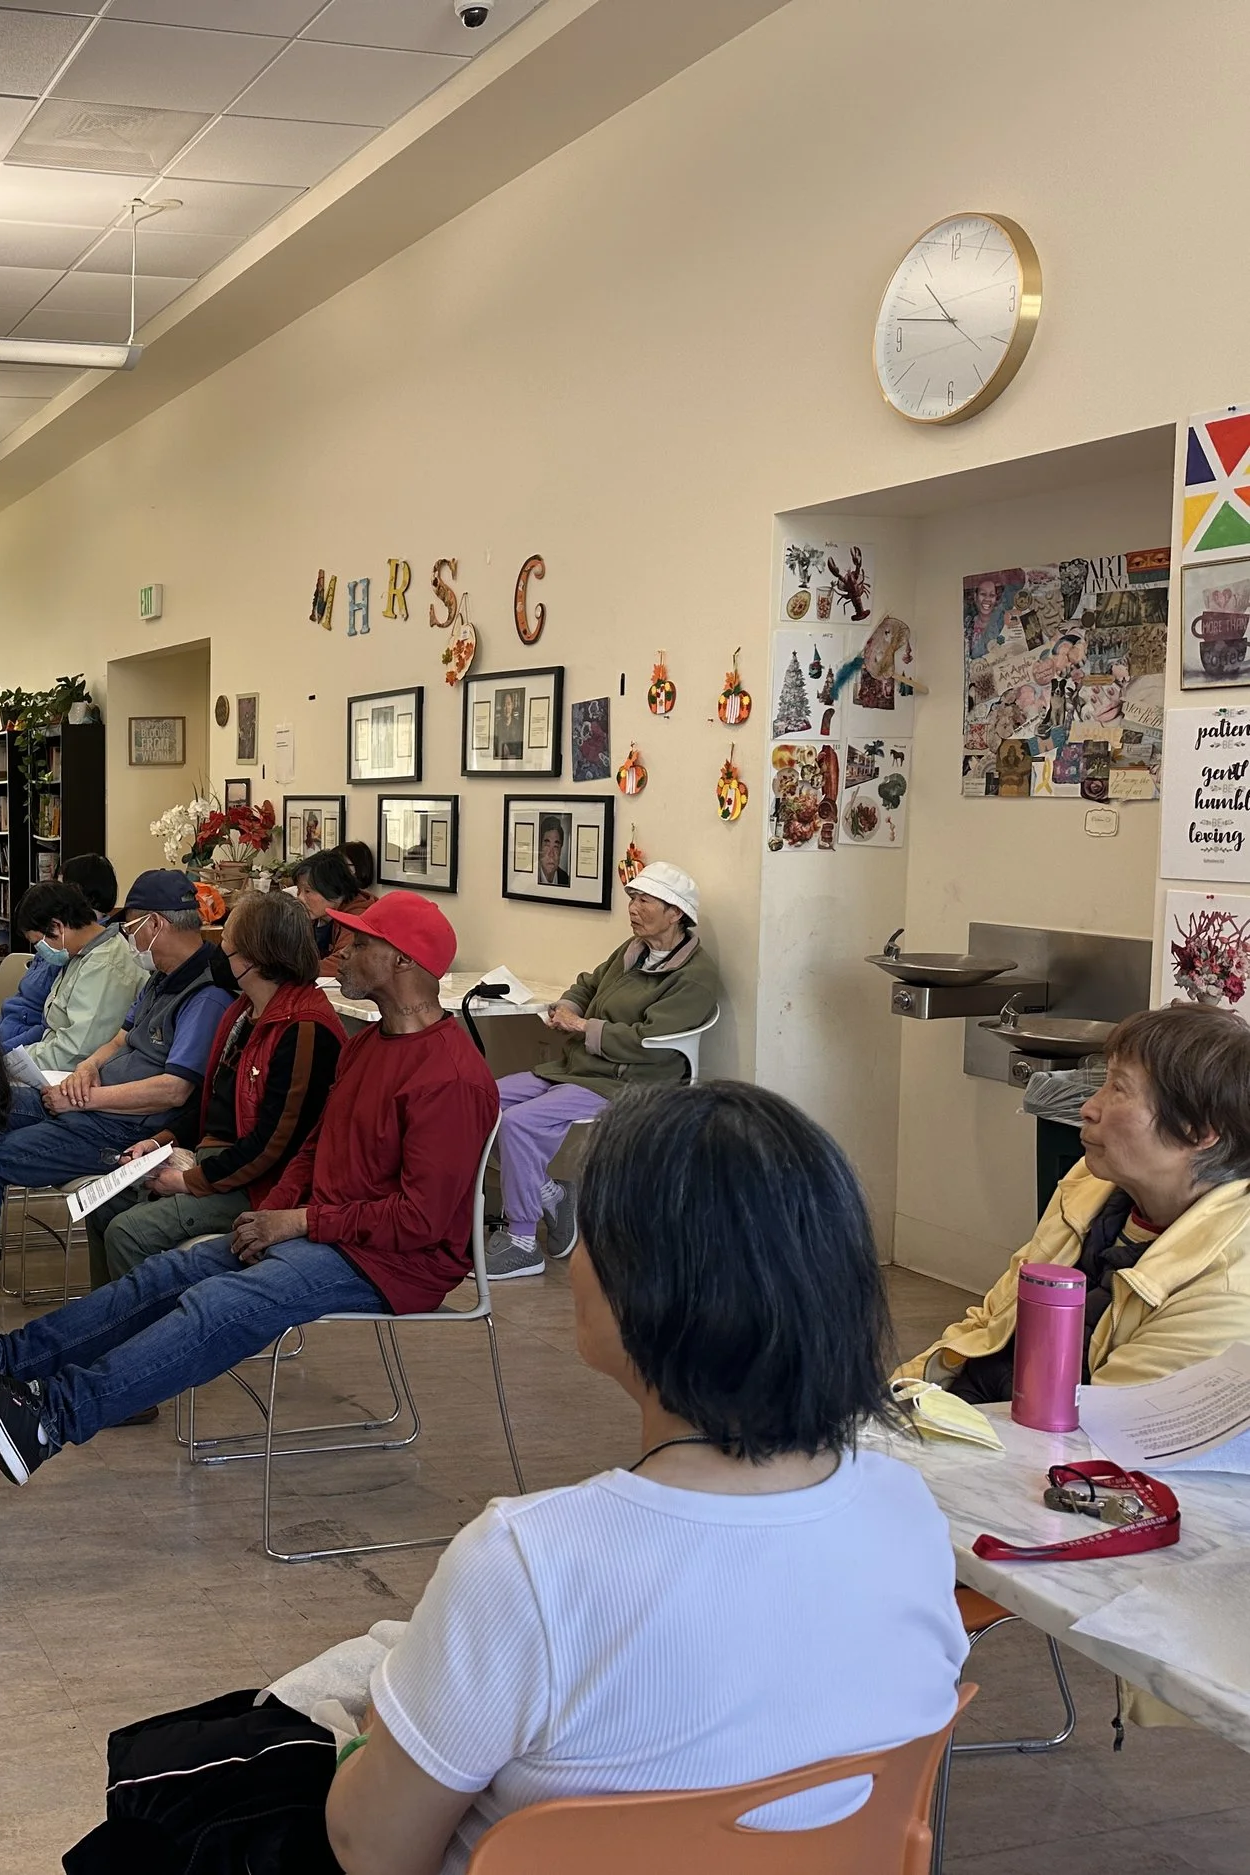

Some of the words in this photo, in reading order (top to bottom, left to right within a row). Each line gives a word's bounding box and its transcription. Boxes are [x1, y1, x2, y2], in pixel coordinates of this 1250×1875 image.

[951, 232, 962, 262] 12
[1008, 285, 1016, 313] 3
[896, 327, 903, 353] 9
[947, 380, 954, 407] 6
[1087, 554, 1127, 579] ART
[1082, 576, 1128, 594] LIVING
[140, 586, 153, 617] EXIT
[1202, 620, 1223, 634] MORE
[1226, 617, 1247, 632] THAN
[1195, 718, 1250, 750] patien
[1222, 739, 1234, 749] BE
[1202, 759, 1250, 787] gentl
[1194, 787, 1250, 811] humbl
[1222, 783, 1234, 793] BE
[1211, 818, 1223, 828] BE
[1189, 821, 1246, 852] loving
